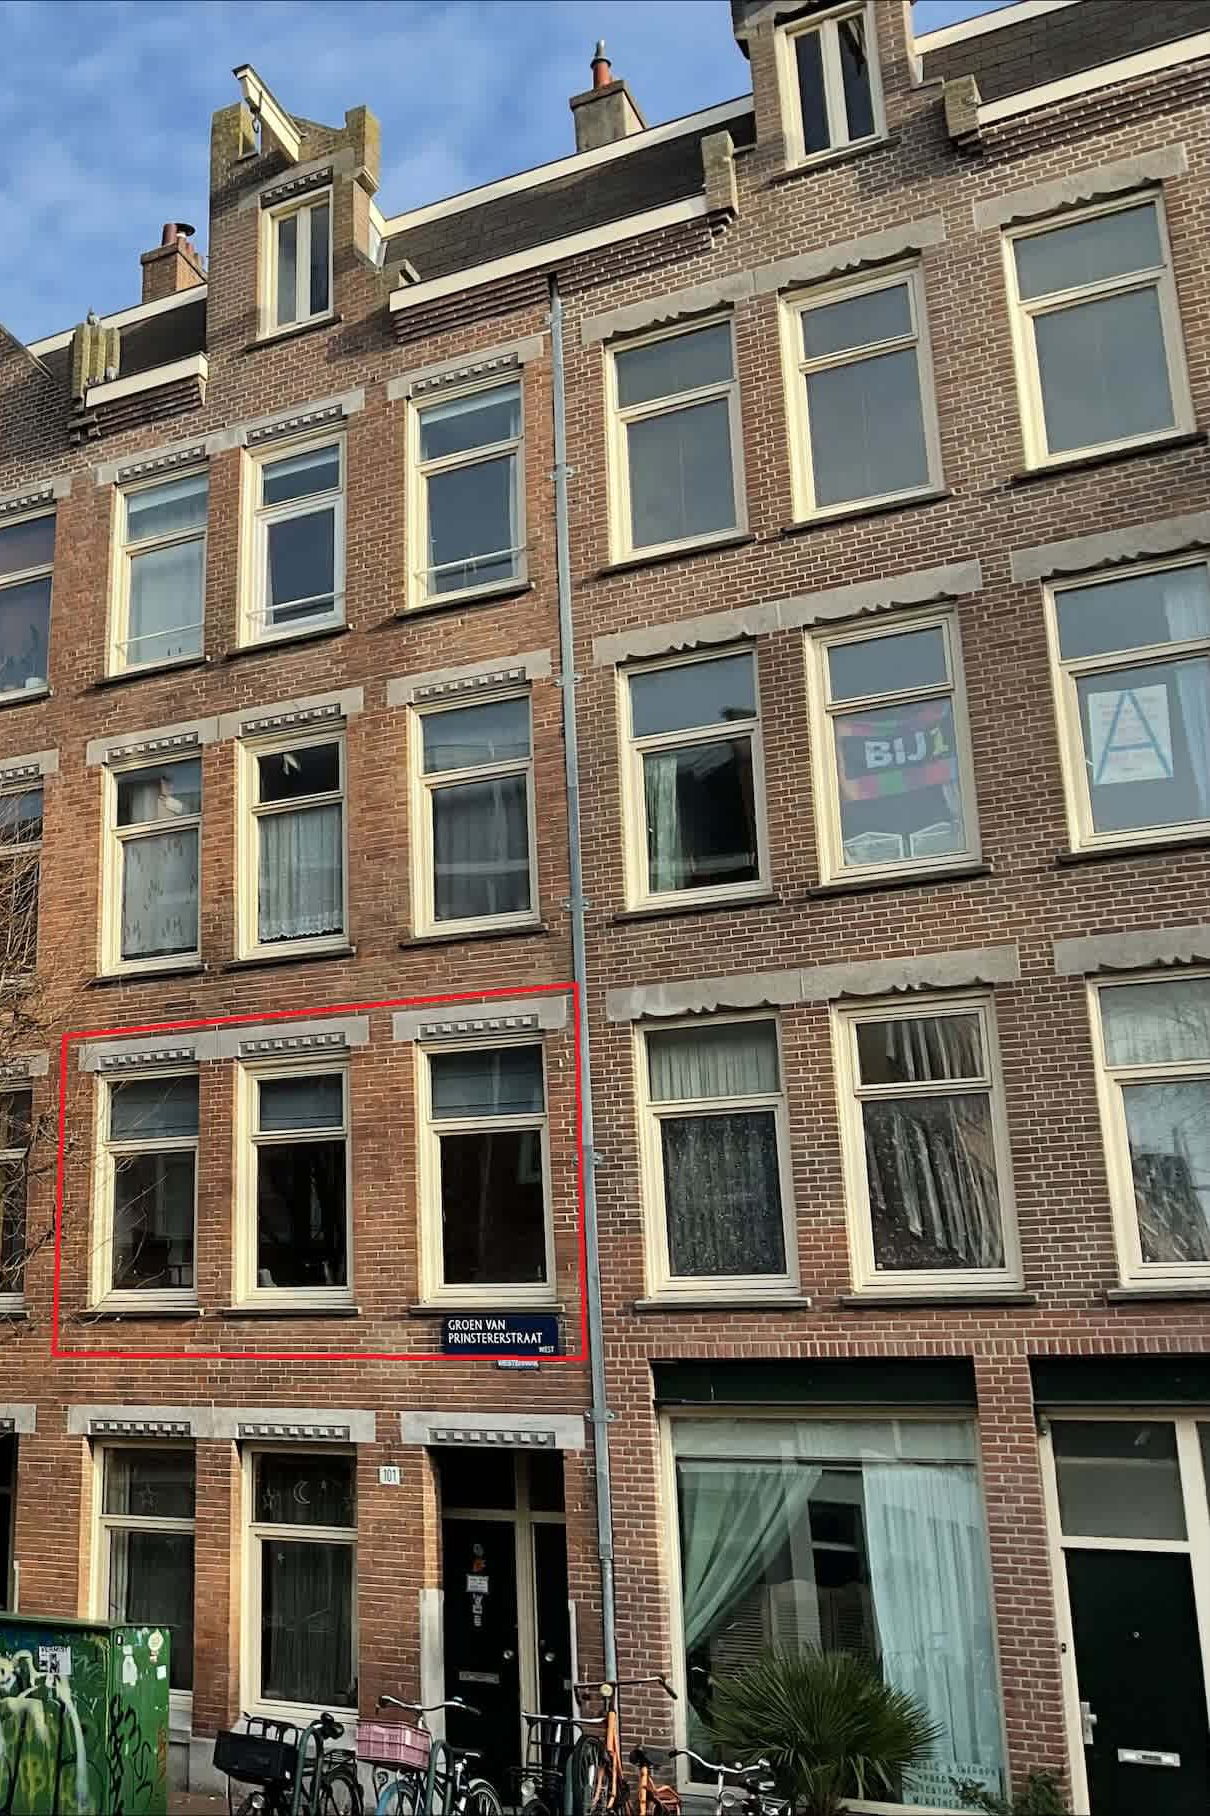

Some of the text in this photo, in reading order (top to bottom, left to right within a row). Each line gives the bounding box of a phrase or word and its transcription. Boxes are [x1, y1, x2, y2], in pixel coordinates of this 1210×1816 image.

[864, 727, 951, 769] BIJ1
[448, 1319, 506, 1331] GROEN VAN
[448, 1332, 543, 1344] PRINSTERERSTRAAT
[538, 1345, 555, 1353] WEST
[383, 1467, 397, 1482] 101
